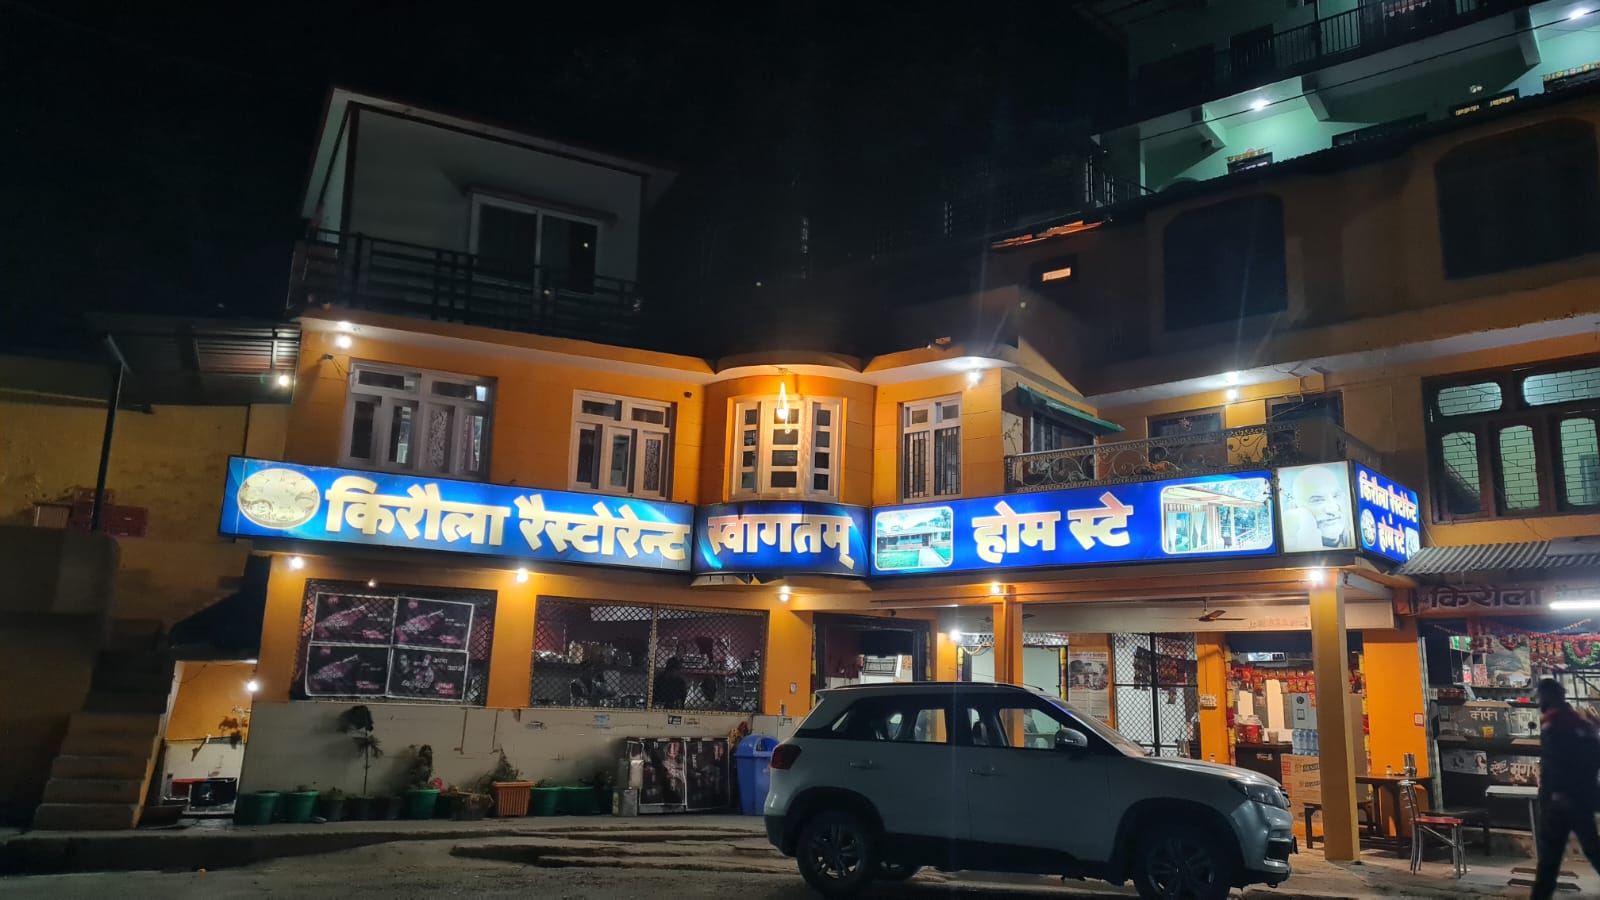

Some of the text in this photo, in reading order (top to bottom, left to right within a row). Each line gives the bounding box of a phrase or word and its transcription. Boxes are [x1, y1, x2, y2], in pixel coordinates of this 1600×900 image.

[325, 476, 691, 561] किरौला रैस्टोरेन्ट
[707, 513, 854, 569] स्वागतम्
[972, 491, 1134, 564] होम स्टे
